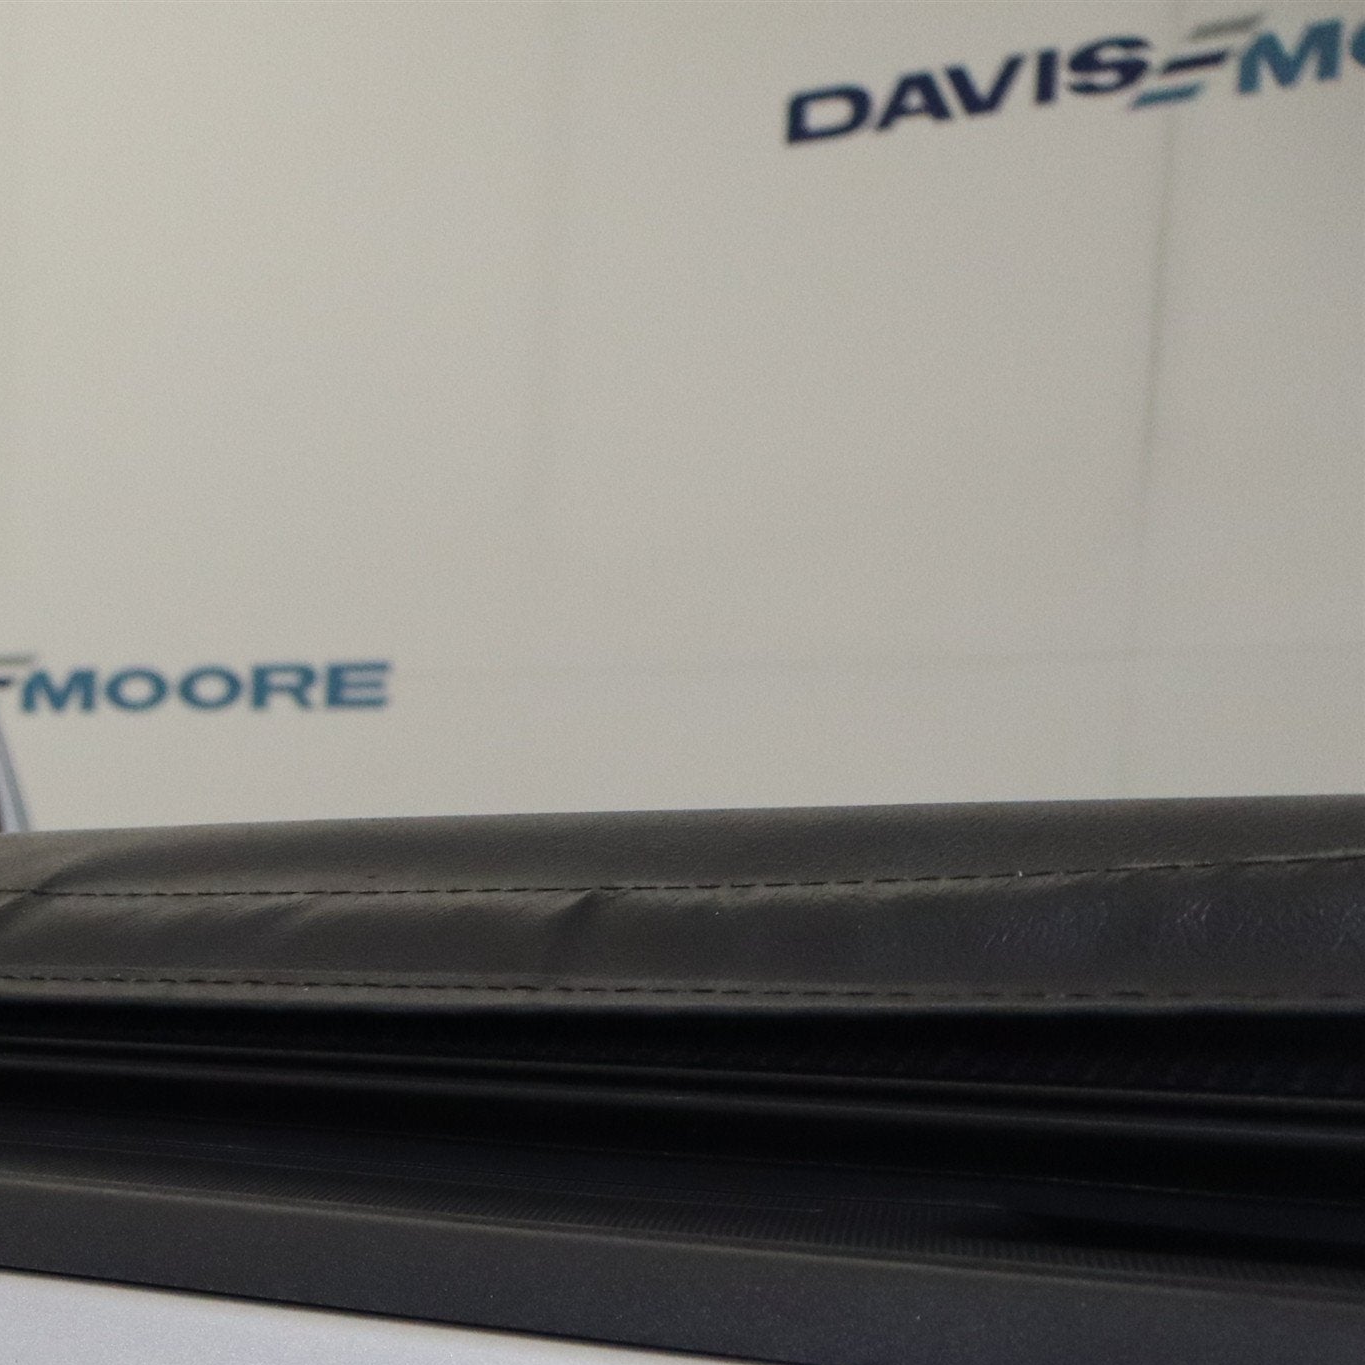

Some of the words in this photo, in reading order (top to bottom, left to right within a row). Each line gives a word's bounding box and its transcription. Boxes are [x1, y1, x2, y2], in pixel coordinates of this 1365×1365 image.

[785, 36, 1151, 144] DAVIS
[1235, 18, 1365, 95] M
[21, 660, 392, 713] MOORE
